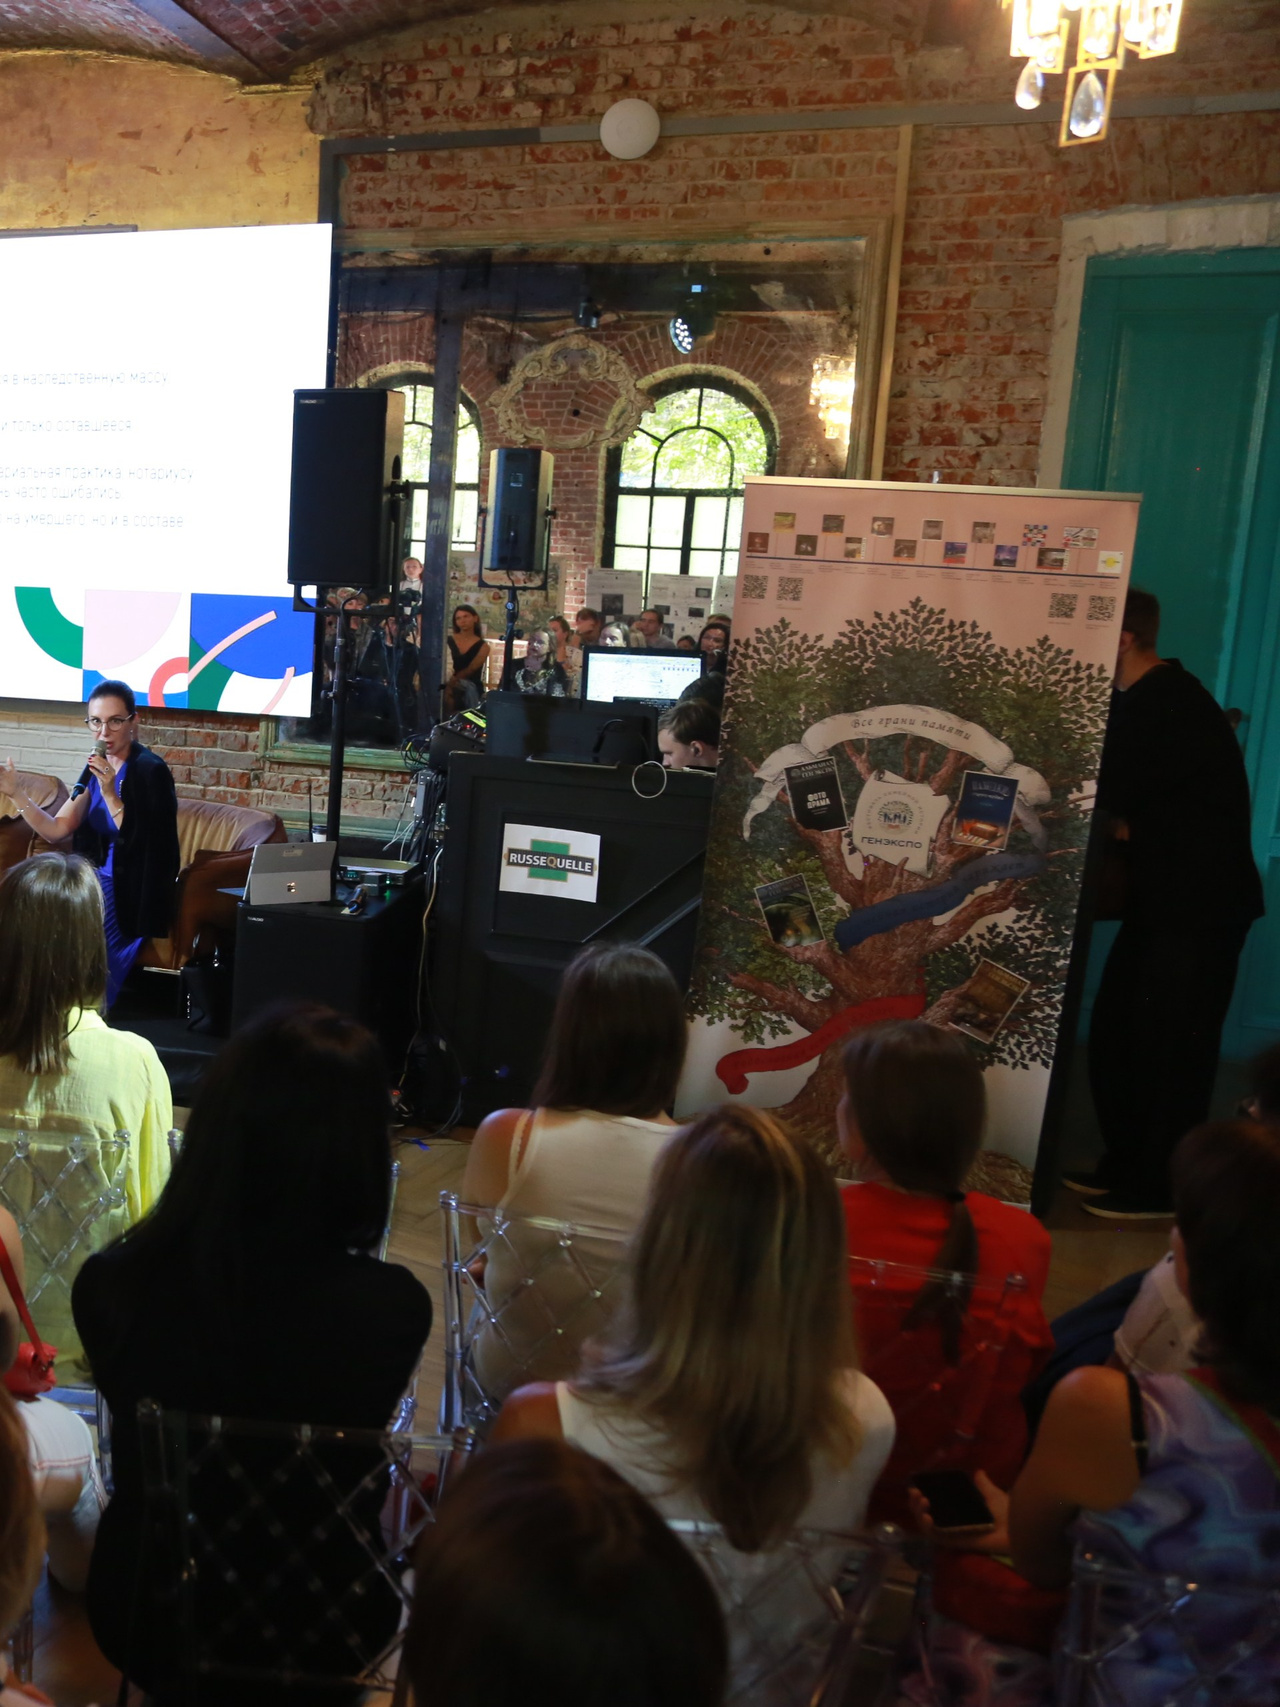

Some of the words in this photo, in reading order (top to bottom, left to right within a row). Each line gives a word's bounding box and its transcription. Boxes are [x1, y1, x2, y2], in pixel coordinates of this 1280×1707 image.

[12, 374, 18, 385] в
[23, 372, 125, 388] наследственную
[1, 420, 7, 432] и
[12, 419, 52, 432] только
[56, 418, 132, 432] оставшееся
[128, 467, 194, 483] нотариусу
[14, 487, 47, 499] часто
[6, 513, 20, 524] на
[92, 513, 106, 526] но
[111, 514, 117, 526] и
[122, 514, 128, 526] в
[133, 513, 184, 528] составе
[851, 718, 873, 728] Все
[878, 717, 916, 727] грани
[921, 720, 972, 740] памяти
[861, 837, 922, 848] ГЕНЭКСПО
[509, 853, 592, 872] RUSSEQUELLE
